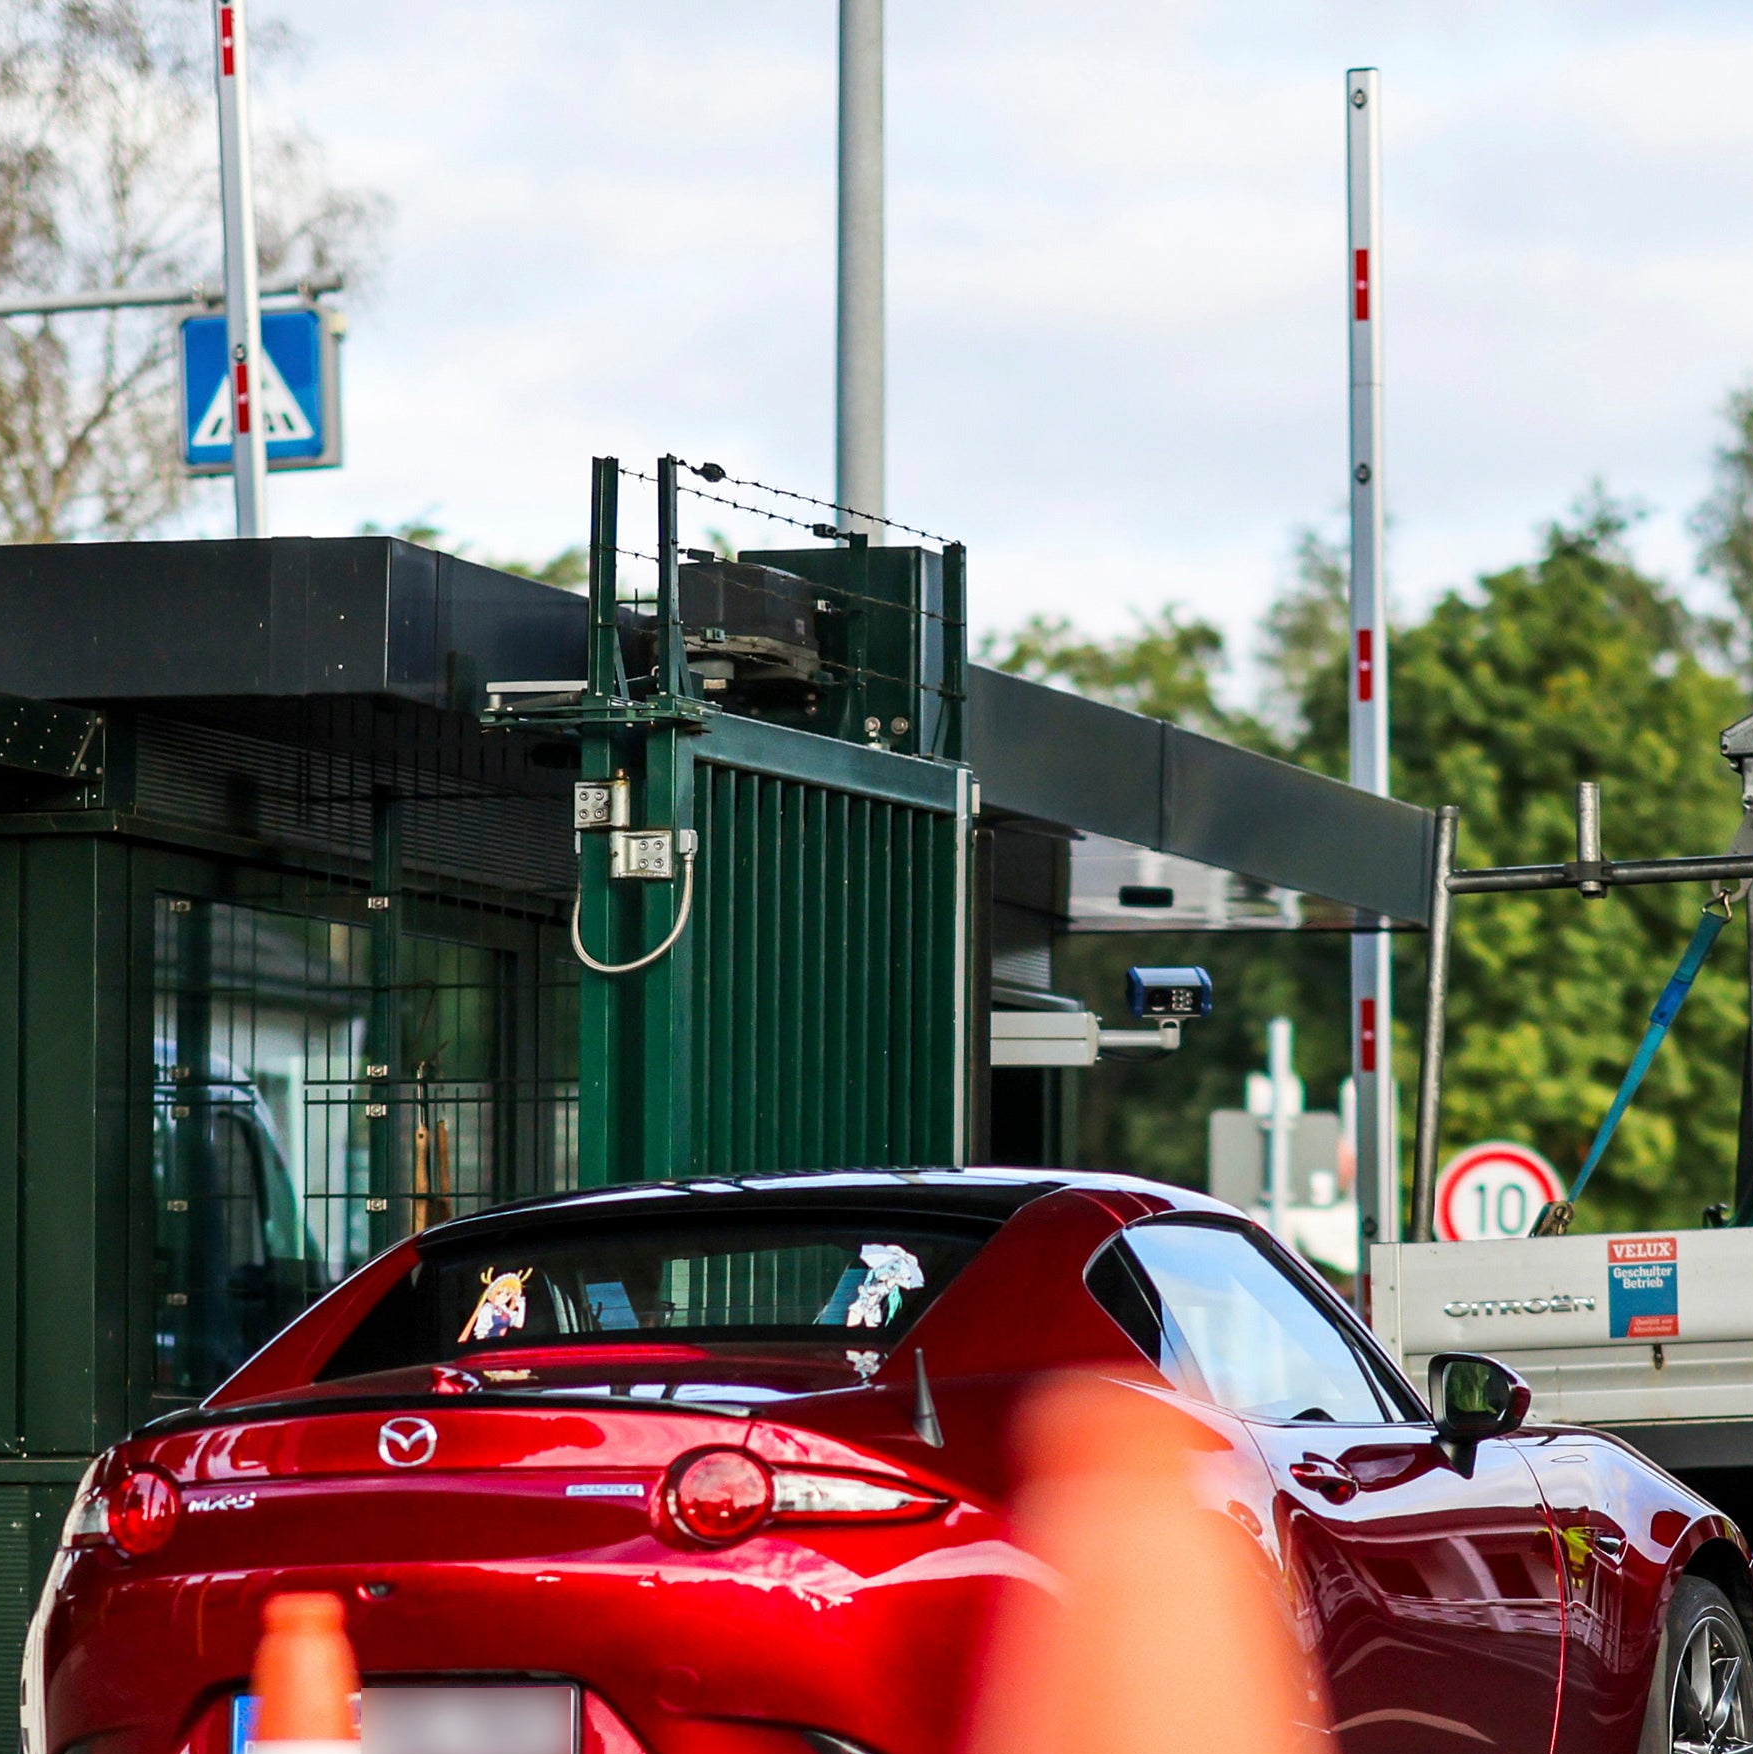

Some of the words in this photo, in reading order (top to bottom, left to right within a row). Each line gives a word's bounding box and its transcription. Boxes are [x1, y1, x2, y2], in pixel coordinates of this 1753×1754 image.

[1474, 1183, 1527, 1235] 10
[1612, 1241, 1671, 1258] VELUX
[1612, 1265, 1673, 1278] Geschulter
[1622, 1276, 1664, 1289] Betrieb
[1443, 1295, 1596, 1318] CITROËN
[187, 1491, 257, 1513] MX-5
